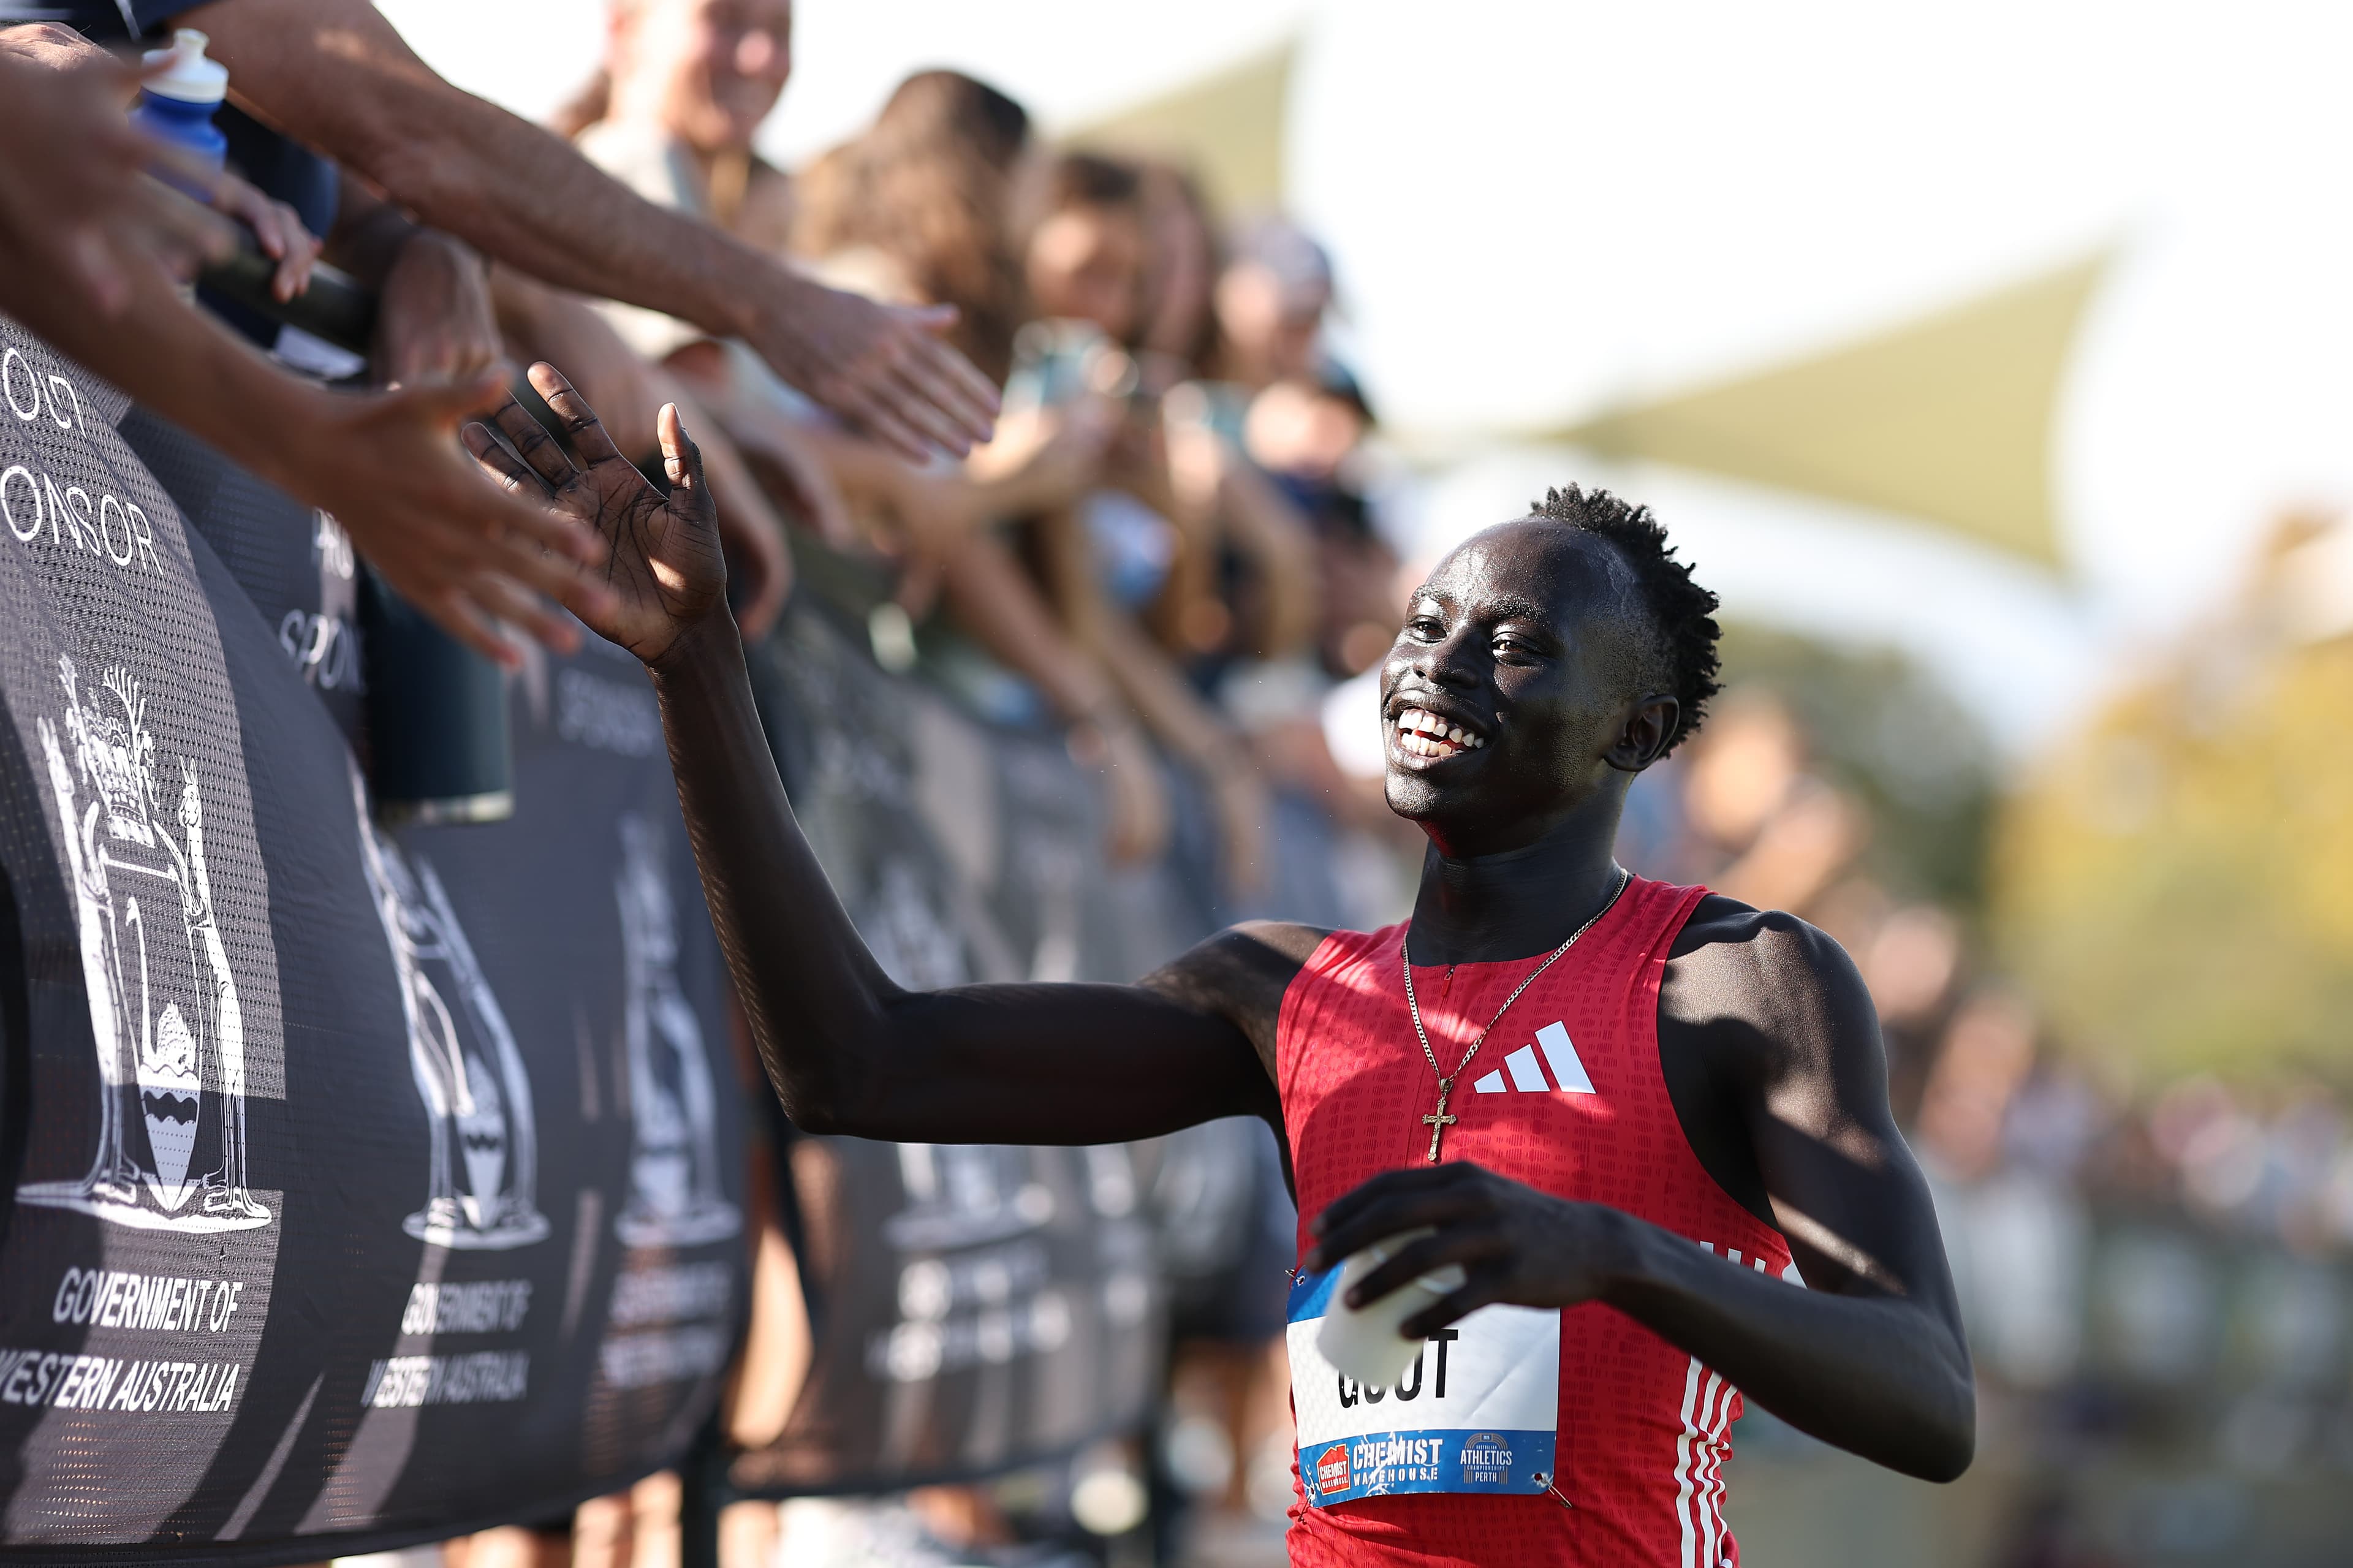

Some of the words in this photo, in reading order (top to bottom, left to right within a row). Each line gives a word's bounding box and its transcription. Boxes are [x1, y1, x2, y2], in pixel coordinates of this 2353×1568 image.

[53, 1267, 213, 1331] GOVERNMENT
[210, 1281, 243, 1333] OF
[1338, 1328, 1459, 1409] GUT
[108, 1360, 240, 1412] AUSTRALIA
[1319, 1460, 1347, 1480] CHEMIST
[1353, 1438, 1443, 1471] CHEMIST
[1460, 1449, 1512, 1466] ATHLETICS
[1475, 1472, 1496, 1482] PERTH
